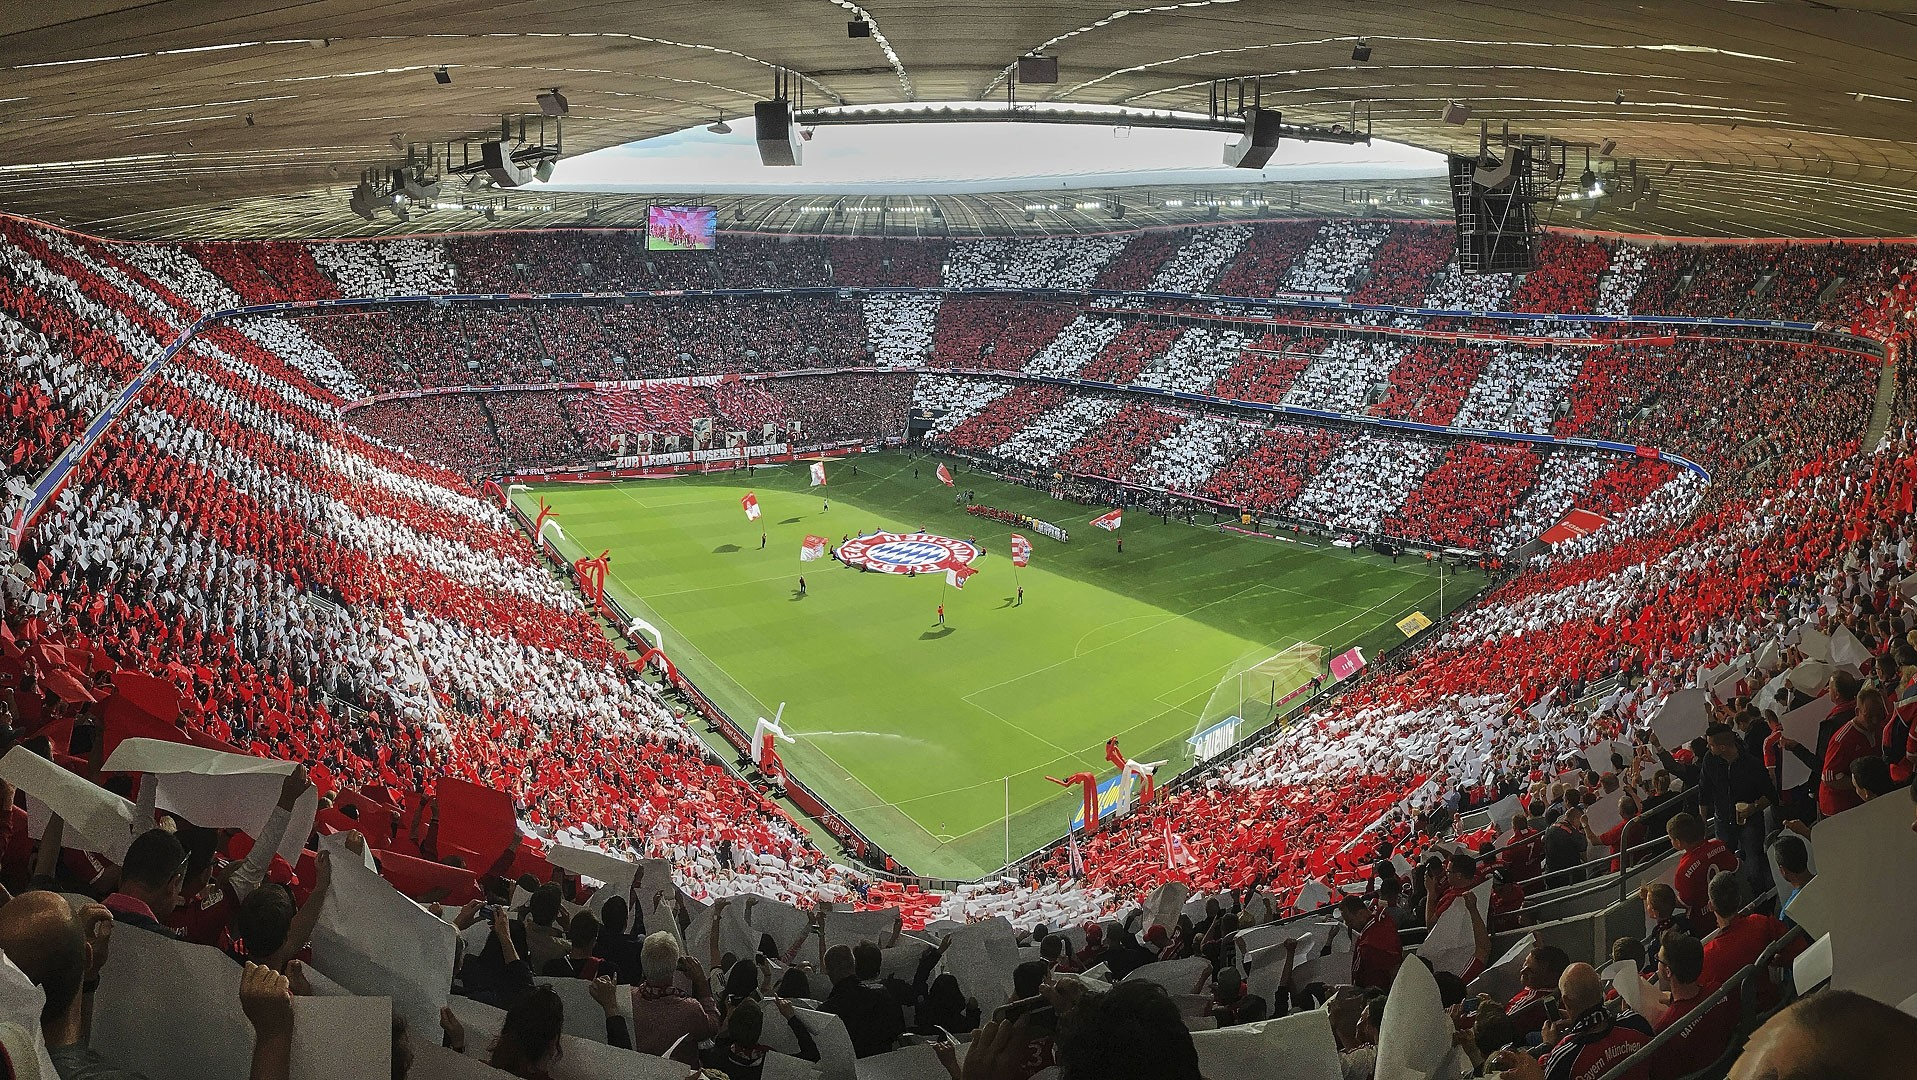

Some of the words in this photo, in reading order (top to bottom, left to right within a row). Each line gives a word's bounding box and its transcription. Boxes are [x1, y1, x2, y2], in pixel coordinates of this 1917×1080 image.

[692, 375, 723, 387] STADT
[616, 456, 639, 468] ZUR
[641, 452, 690, 466] LEGENDE
[693, 447, 740, 460] UNSERES
[743, 443, 787, 458] VEREINS
[829, 818, 840, 831] FCB
[1685, 860, 1701, 878] BAYERN
[1604, 1040, 1640, 1062] München
